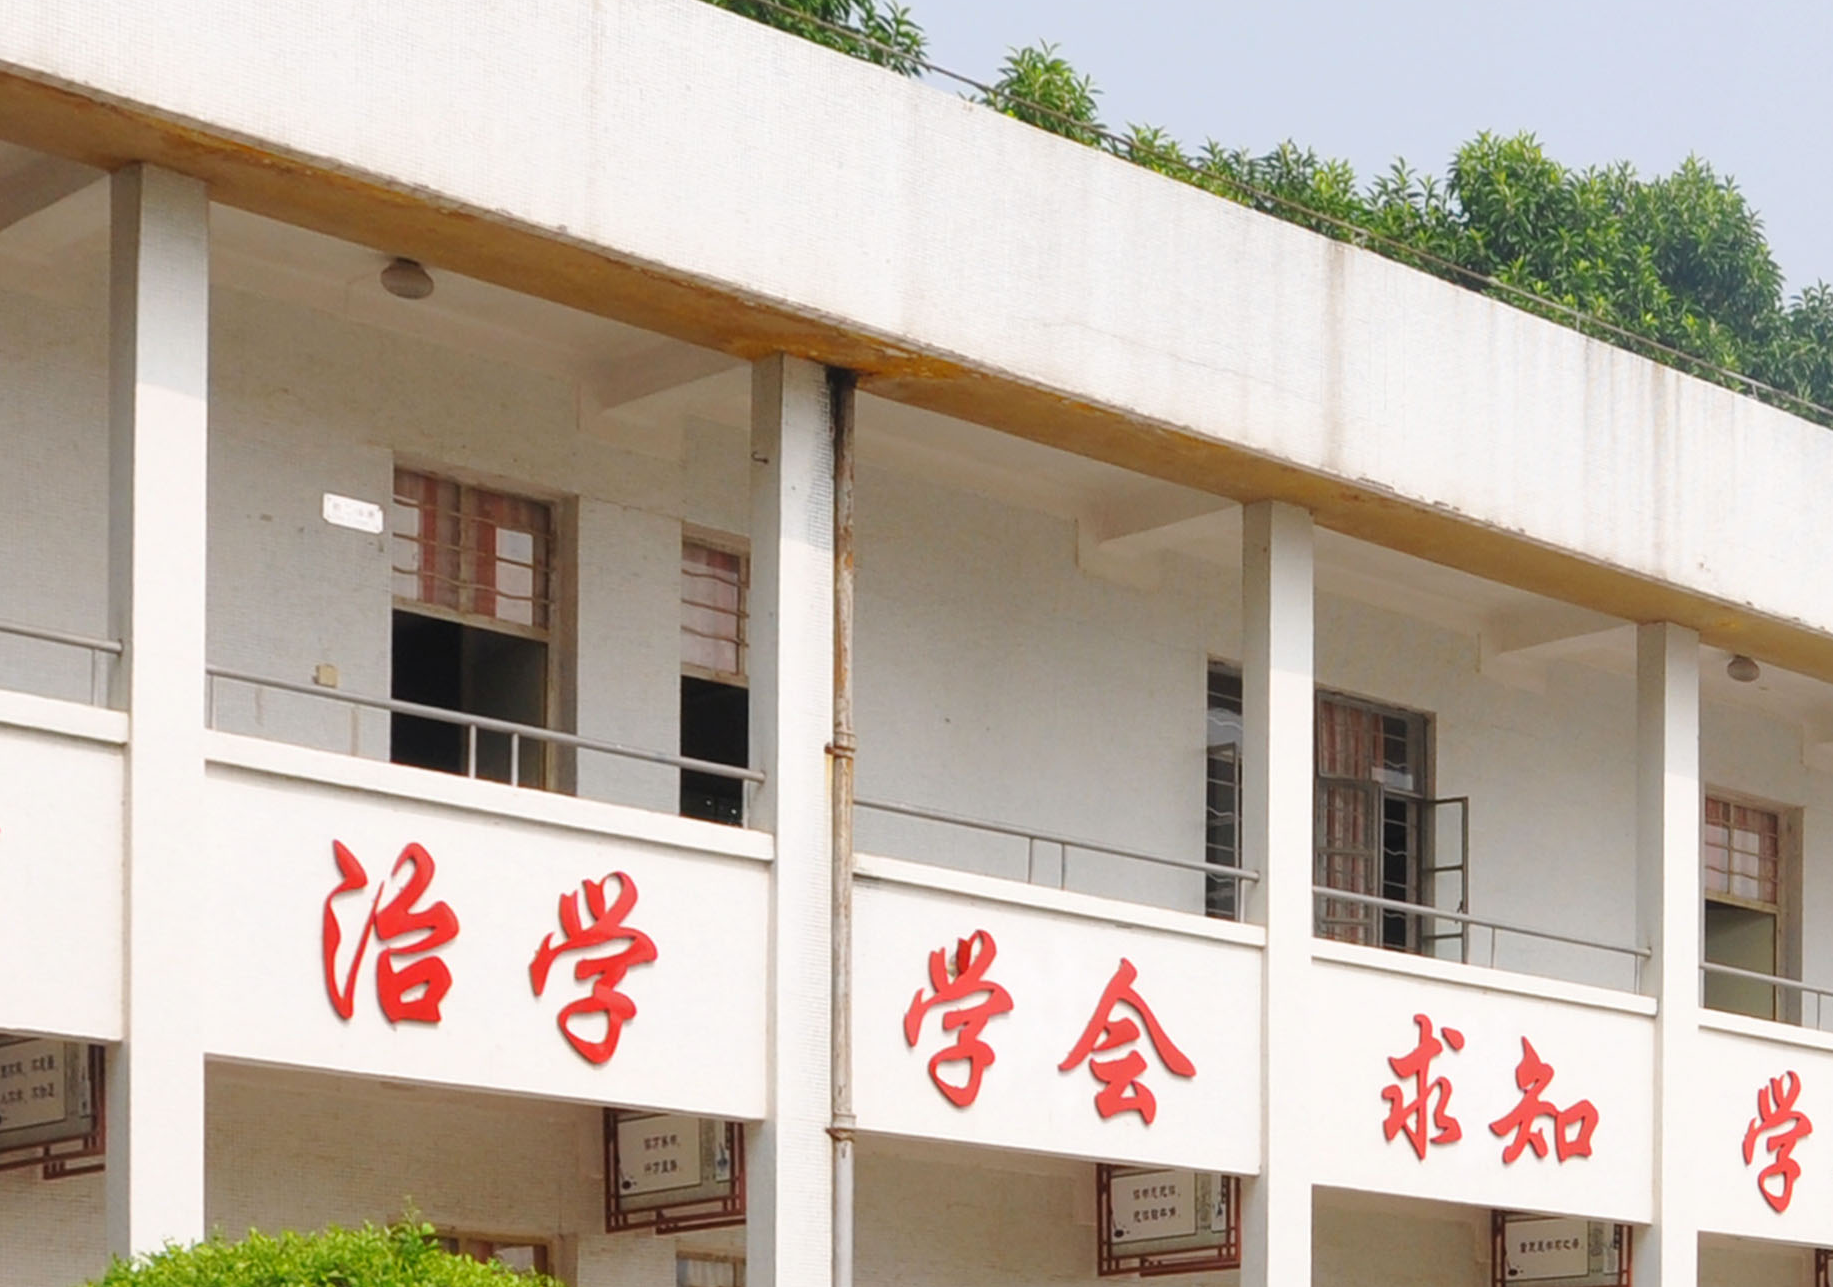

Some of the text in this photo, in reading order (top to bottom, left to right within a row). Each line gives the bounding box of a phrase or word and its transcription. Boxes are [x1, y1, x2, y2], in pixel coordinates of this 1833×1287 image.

[322, 840, 659, 1065] 治学
[904, 930, 1198, 1126] 学会
[1381, 1014, 1600, 1166] 求知
